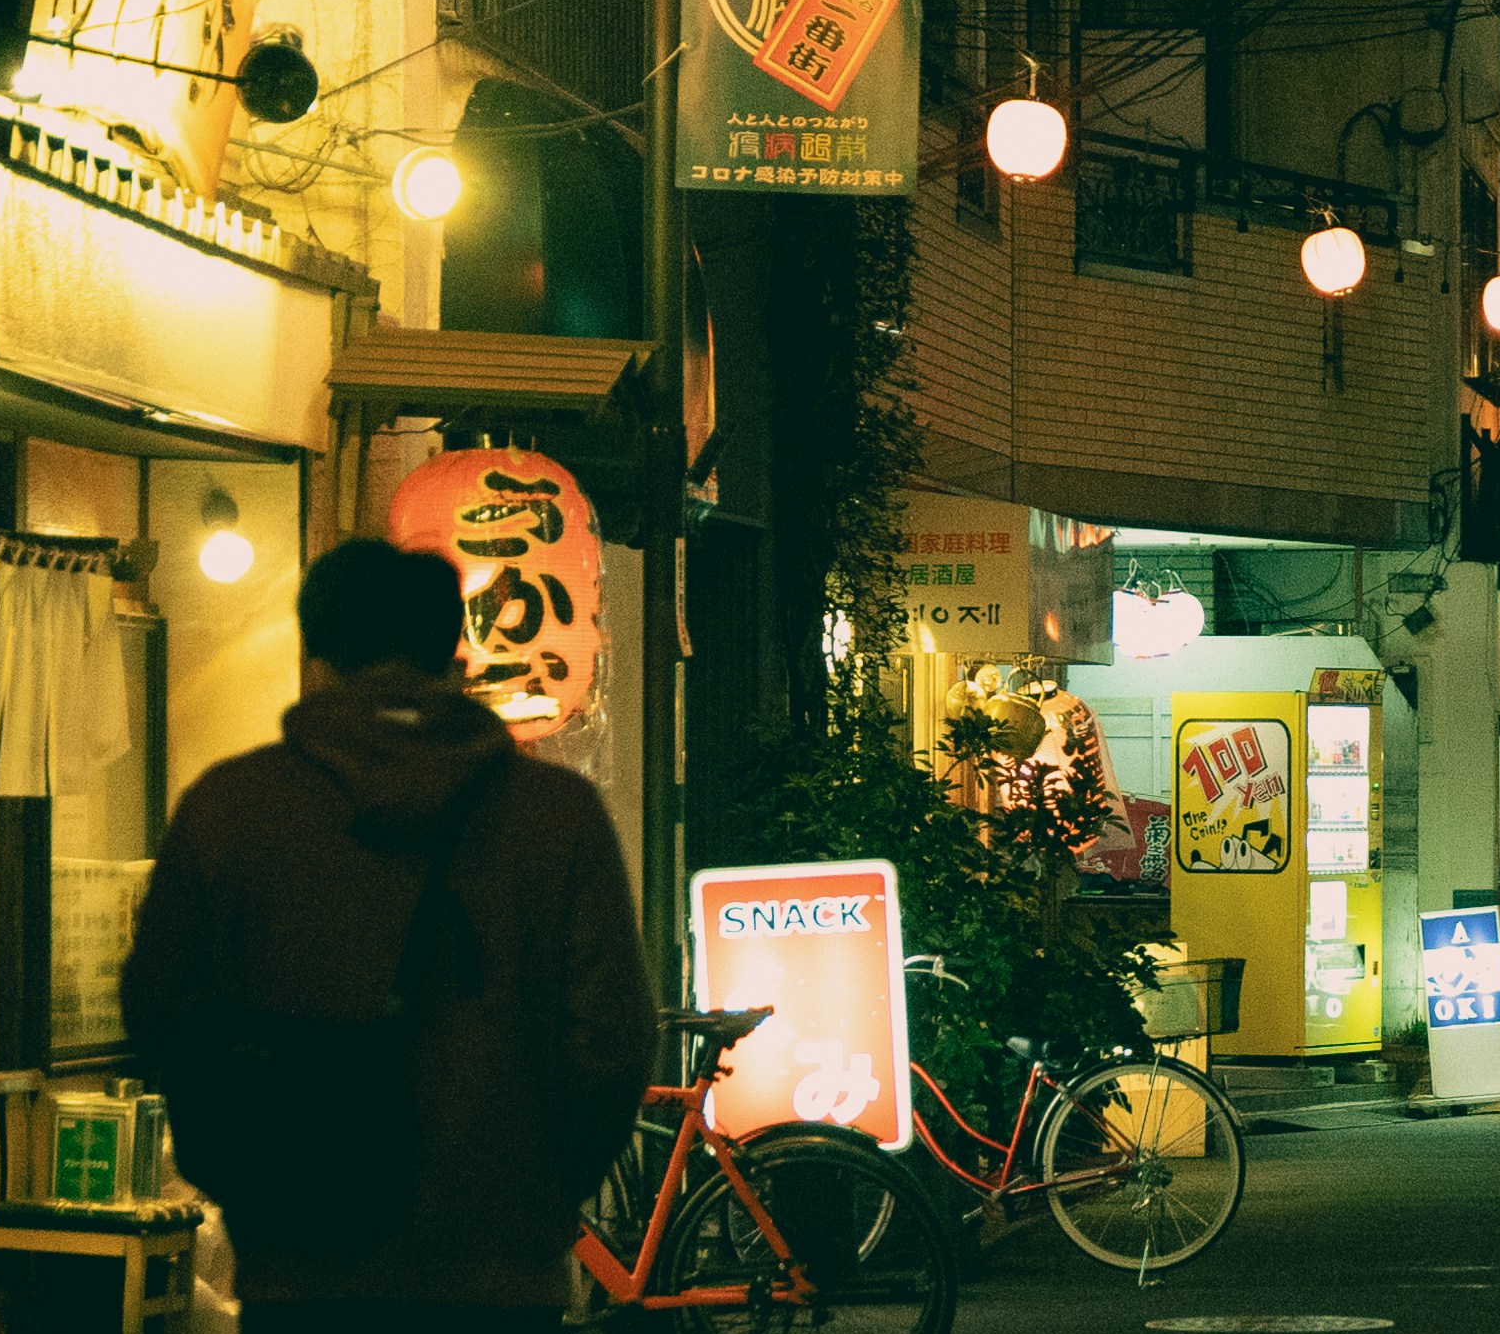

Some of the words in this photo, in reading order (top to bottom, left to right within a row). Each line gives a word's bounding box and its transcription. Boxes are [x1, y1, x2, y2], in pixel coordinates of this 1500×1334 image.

[726, 112, 870, 129] 人と人とのつながり
[727, 130, 868, 163] 疫病退散
[690, 165, 905, 187] コロナ感染予防対策中
[1181, 724, 1269, 805] 100
[722, 898, 866, 936] SNACK
[1434, 994, 1496, 1022] OKI
